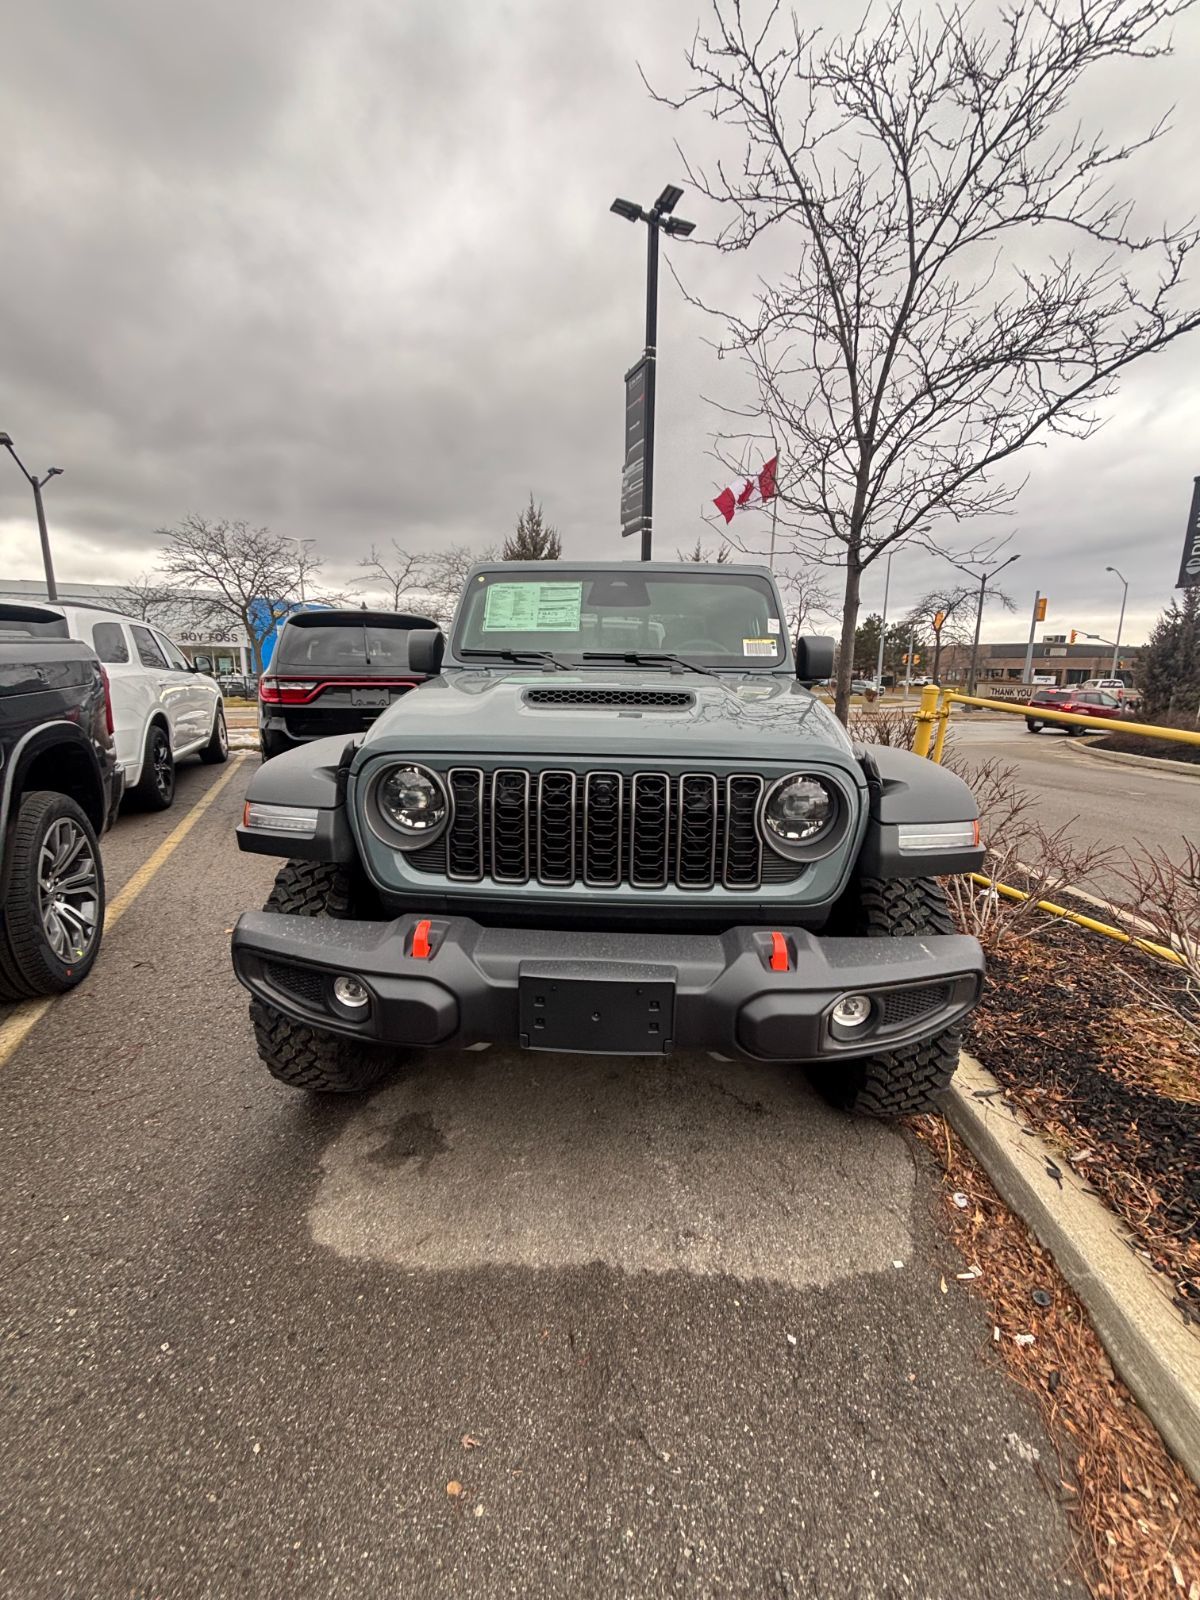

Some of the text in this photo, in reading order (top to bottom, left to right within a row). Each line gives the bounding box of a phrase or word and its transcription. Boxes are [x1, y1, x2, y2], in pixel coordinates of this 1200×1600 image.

[180, 632, 238, 642] ROY FOSS
[991, 688, 1032, 697] THANK YOU
